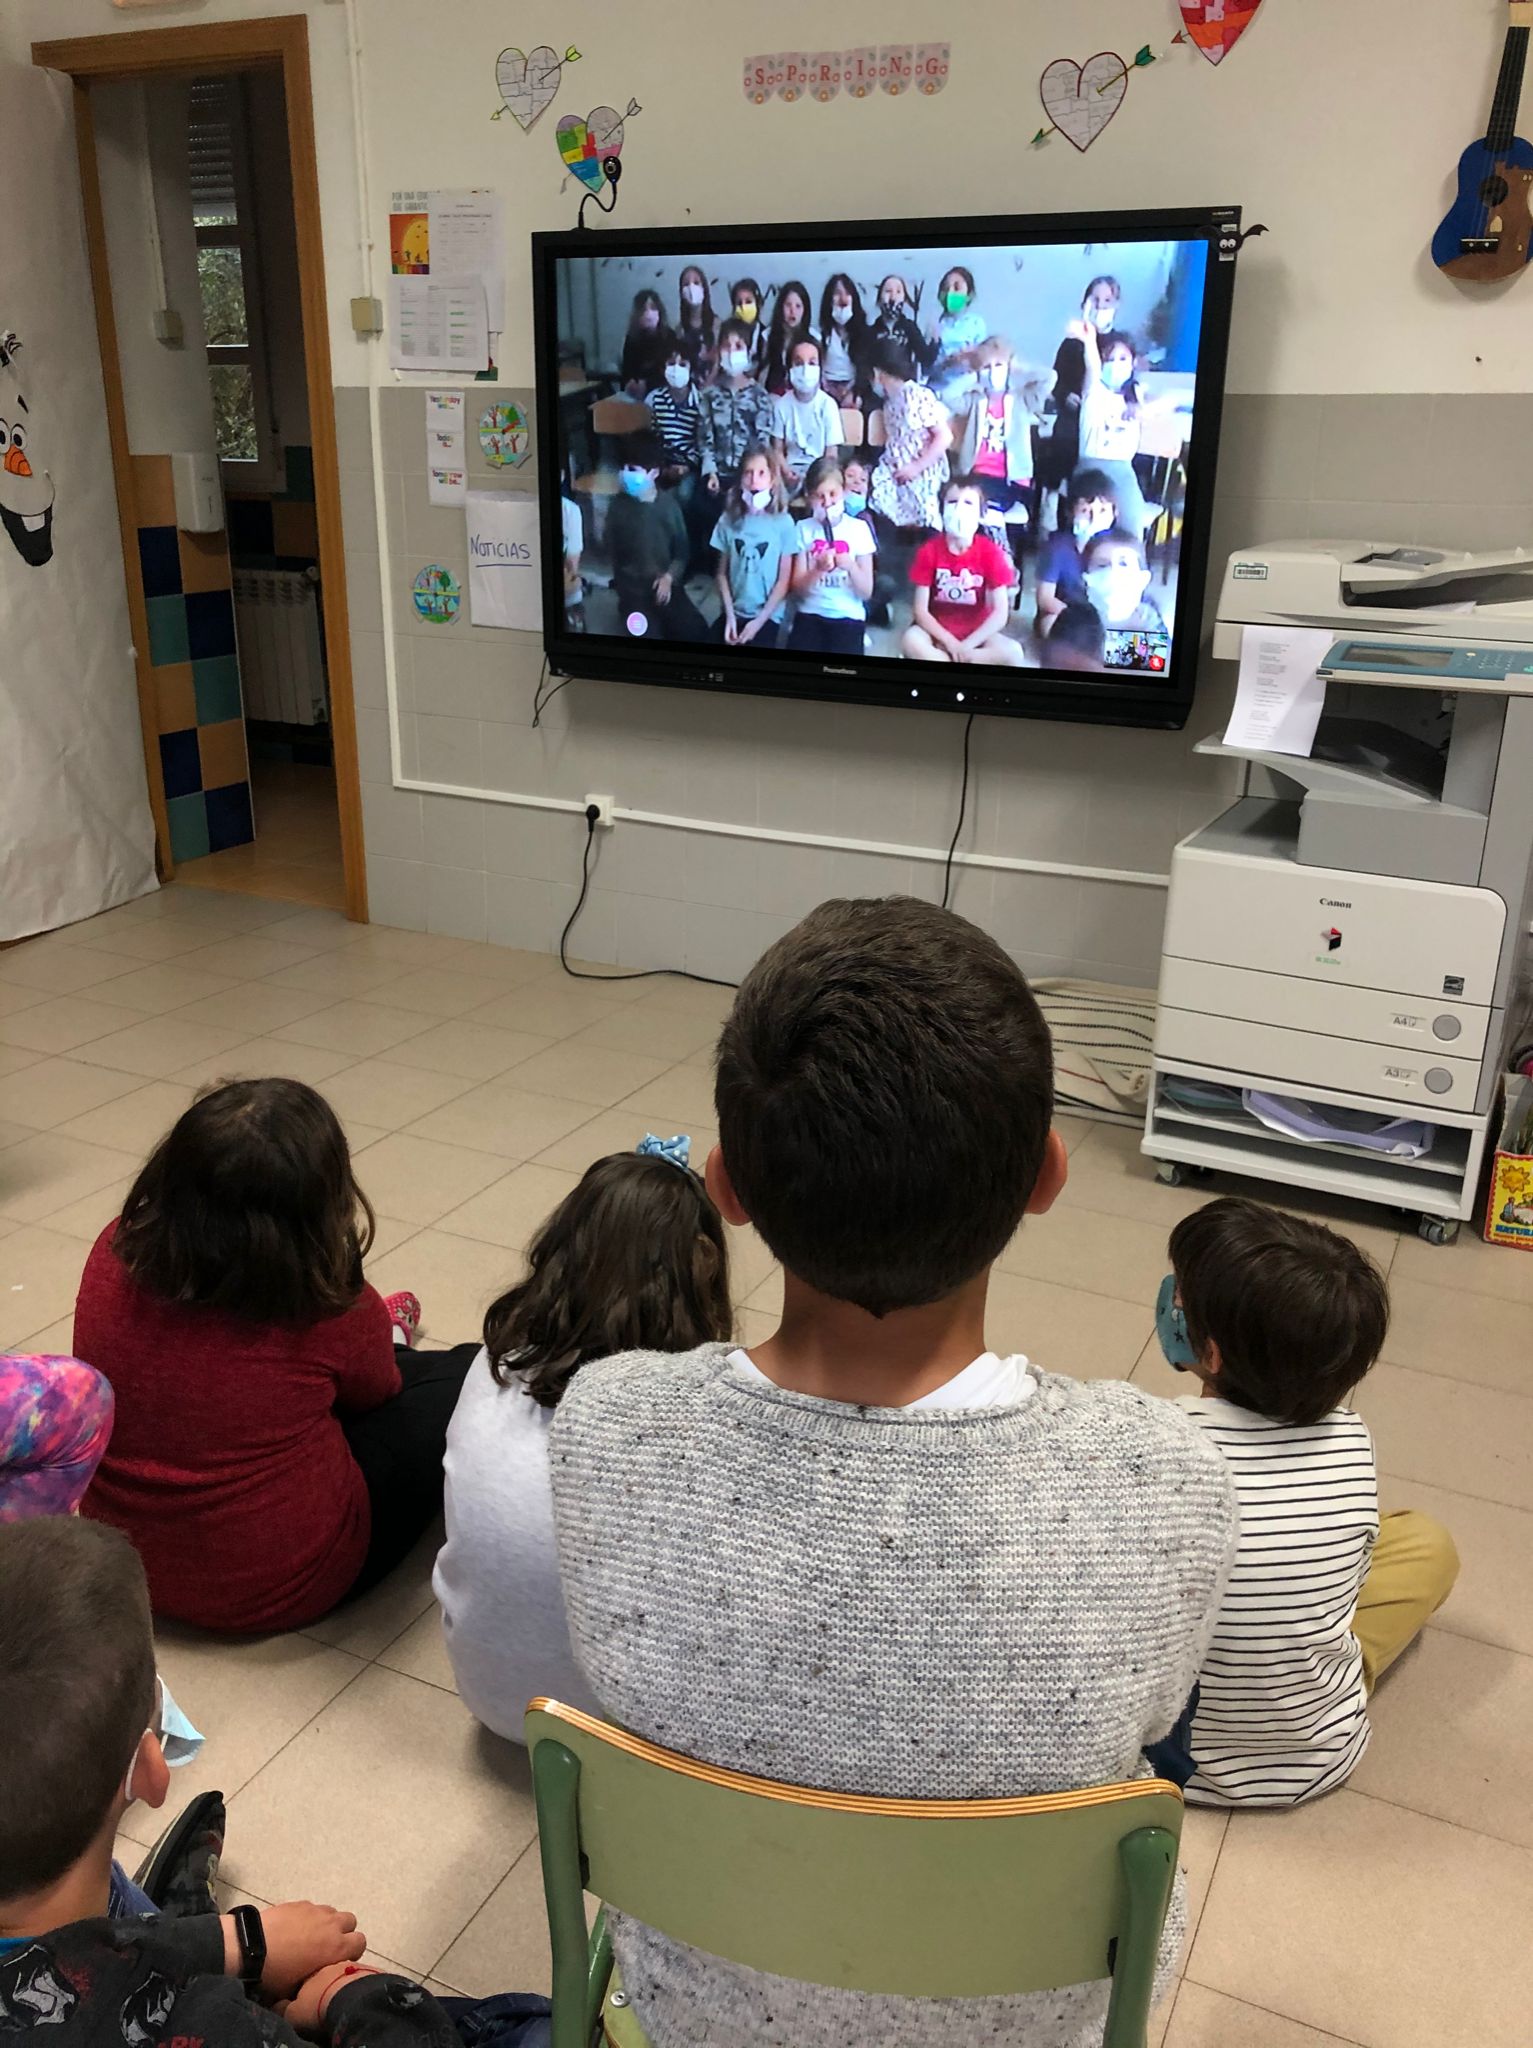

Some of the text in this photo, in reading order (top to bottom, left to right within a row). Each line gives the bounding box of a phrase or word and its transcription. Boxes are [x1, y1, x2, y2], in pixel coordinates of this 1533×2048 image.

[755, 57, 938, 86] SPRING
[470, 534, 531, 560] NOTICIAS
[1319, 897, 1352, 909] Canon
[1393, 1016, 1407, 1026] A4
[1385, 1068, 1399, 1078] A3
